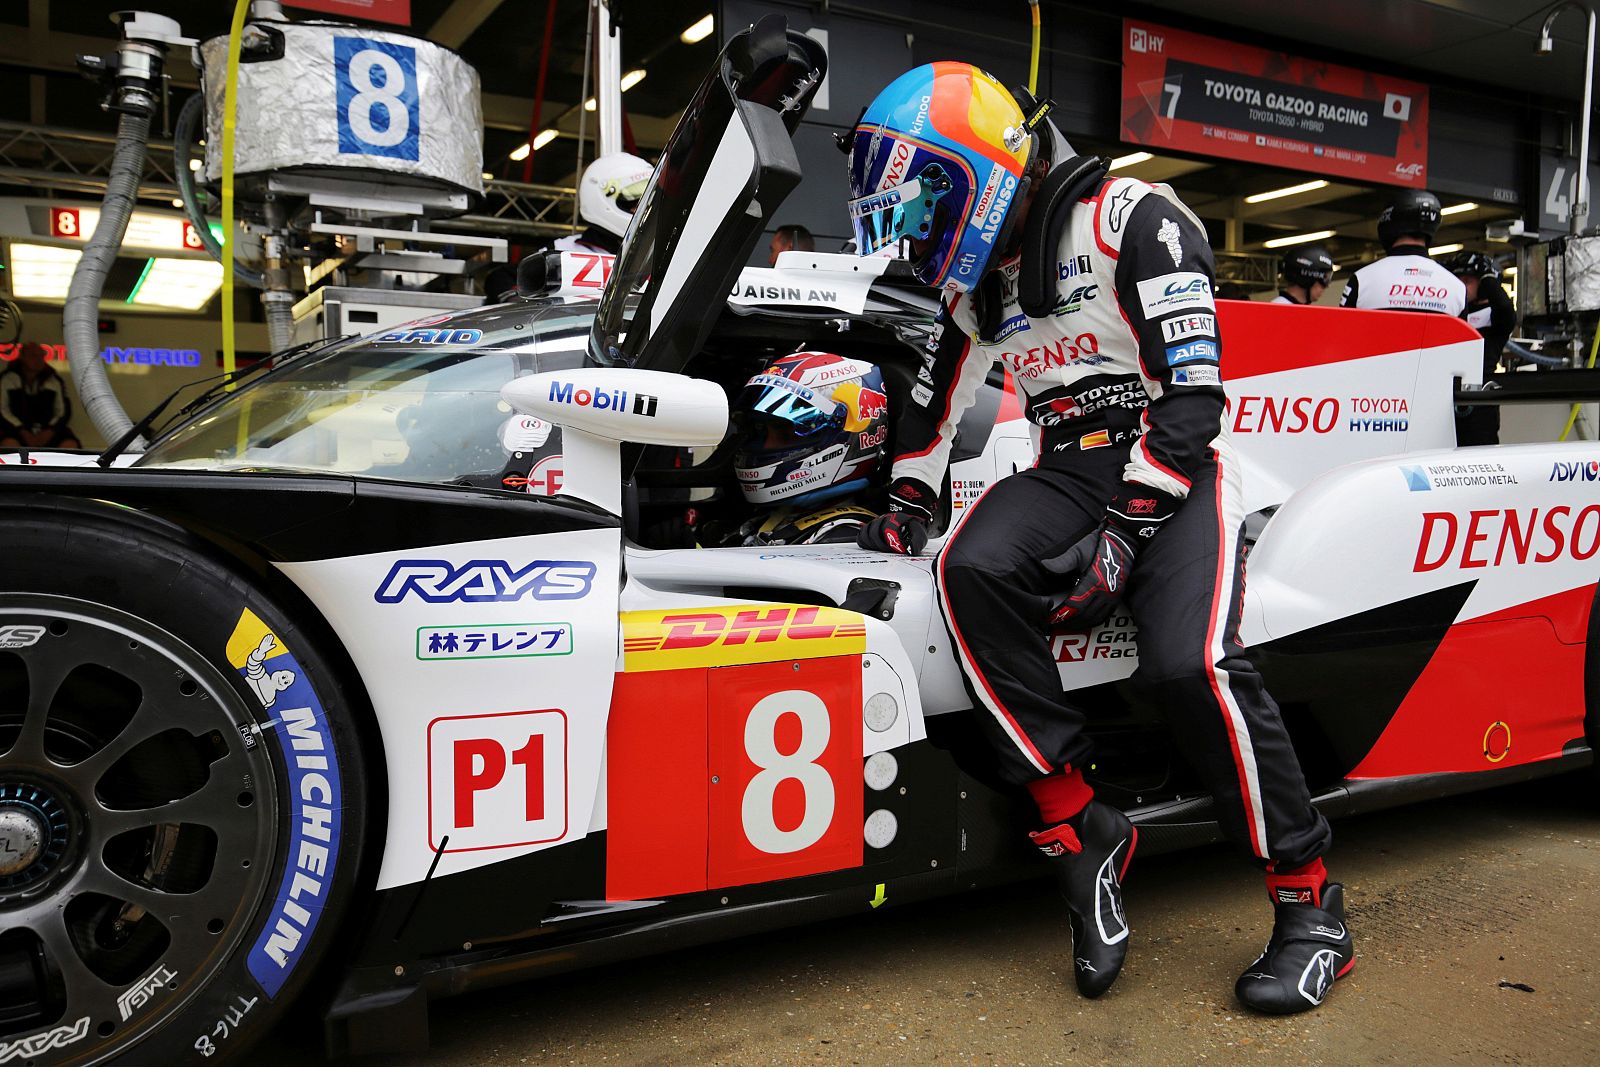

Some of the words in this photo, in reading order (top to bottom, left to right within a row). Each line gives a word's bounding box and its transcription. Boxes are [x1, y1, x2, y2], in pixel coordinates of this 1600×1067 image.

[1149, 35, 1164, 52] HY
[347, 49, 410, 147] 8
[1164, 84, 1181, 119] 7
[1204, 79, 1261, 106] TOYOTA
[1265, 93, 1315, 116] GAZOO
[1318, 103, 1369, 127] RACING
[910, 95, 931, 135] kimoa
[1250, 109, 1274, 124] TOYOTA
[1300, 119, 1325, 132] HYBRID
[882, 143, 909, 190] ENSO
[852, 190, 901, 216] BRID
[975, 183, 995, 219] KODAK
[980, 175, 1016, 244] ALONSO
[58, 211, 77, 235] 8
[1056, 257, 1078, 281] bil
[744, 285, 801, 300] AISIN
[808, 290, 838, 302] AW
[1389, 284, 1448, 299] DENSO
[1417, 301, 1447, 310] HYBRID
[1167, 317, 1212, 340] JTEKT
[1001, 332, 1099, 373] DENSO
[1174, 343, 1215, 362] AISIN
[820, 364, 858, 381] DENSO
[548, 381, 627, 413] Mobil
[1351, 398, 1409, 413] TOYOTA
[1226, 396, 1341, 435] ENSO
[1350, 418, 1409, 432] HYBRID
[737, 470, 759, 479] DENSO
[789, 470, 810, 480] BELL
[1429, 464, 1467, 476] NIPPON
[1470, 463, 1497, 473] STEEL
[1497, 463, 1505, 472] &
[1434, 477, 1487, 488] SUMITOMO
[1489, 475, 1518, 485] METAL
[1549, 461, 1600, 482] ADVIC
[770, 481, 803, 496] RICHARD
[805, 473, 826, 485] MILLE
[1412, 504, 1600, 573] DENSO
[375, 559, 597, 603] RAYS
[428, 628, 566, 654] 林テレンプ
[660, 608, 837, 650] DHL
[1096, 631, 1139, 644] GAZ
[1092, 646, 1139, 660] Rac
[240, 727, 255, 748] FL08
[454, 733, 545, 829] P1
[741, 690, 836, 854] 8
[264, 707, 333, 969] MICHELIN
